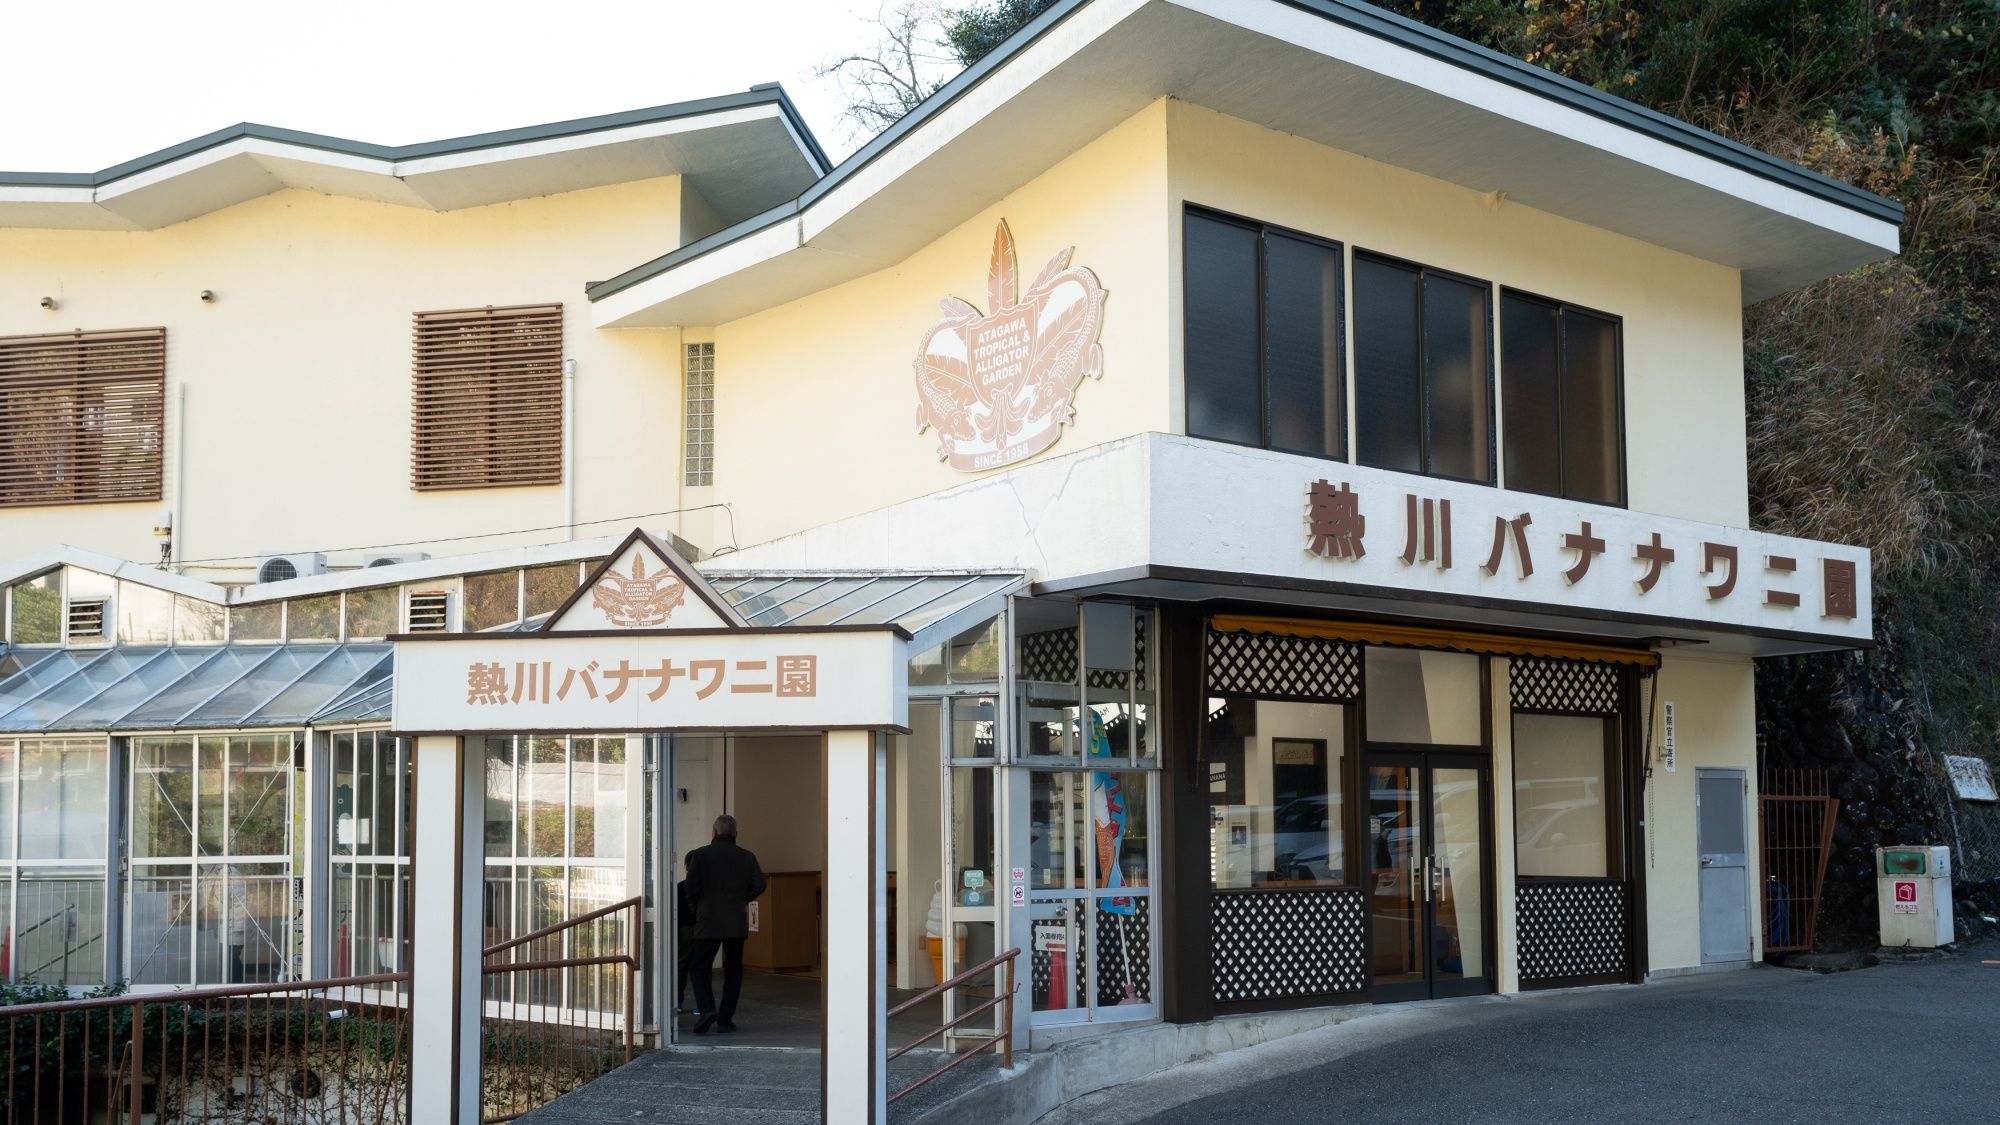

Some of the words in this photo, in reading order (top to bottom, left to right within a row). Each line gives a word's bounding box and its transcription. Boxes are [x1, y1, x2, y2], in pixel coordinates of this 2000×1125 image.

[978, 317, 1026, 345] ATAGAWA
[974, 334, 1020, 361] TROPICAL
[1023, 330, 1030, 343] &
[976, 346, 1029, 374] ALLIGATOR
[982, 361, 1022, 385] GARDEN
[975, 453, 1003, 468] SINCE
[1304, 479, 1857, 619] 熱川バナナワニ園
[467, 655, 817, 706] 熱川バナナワニ園
